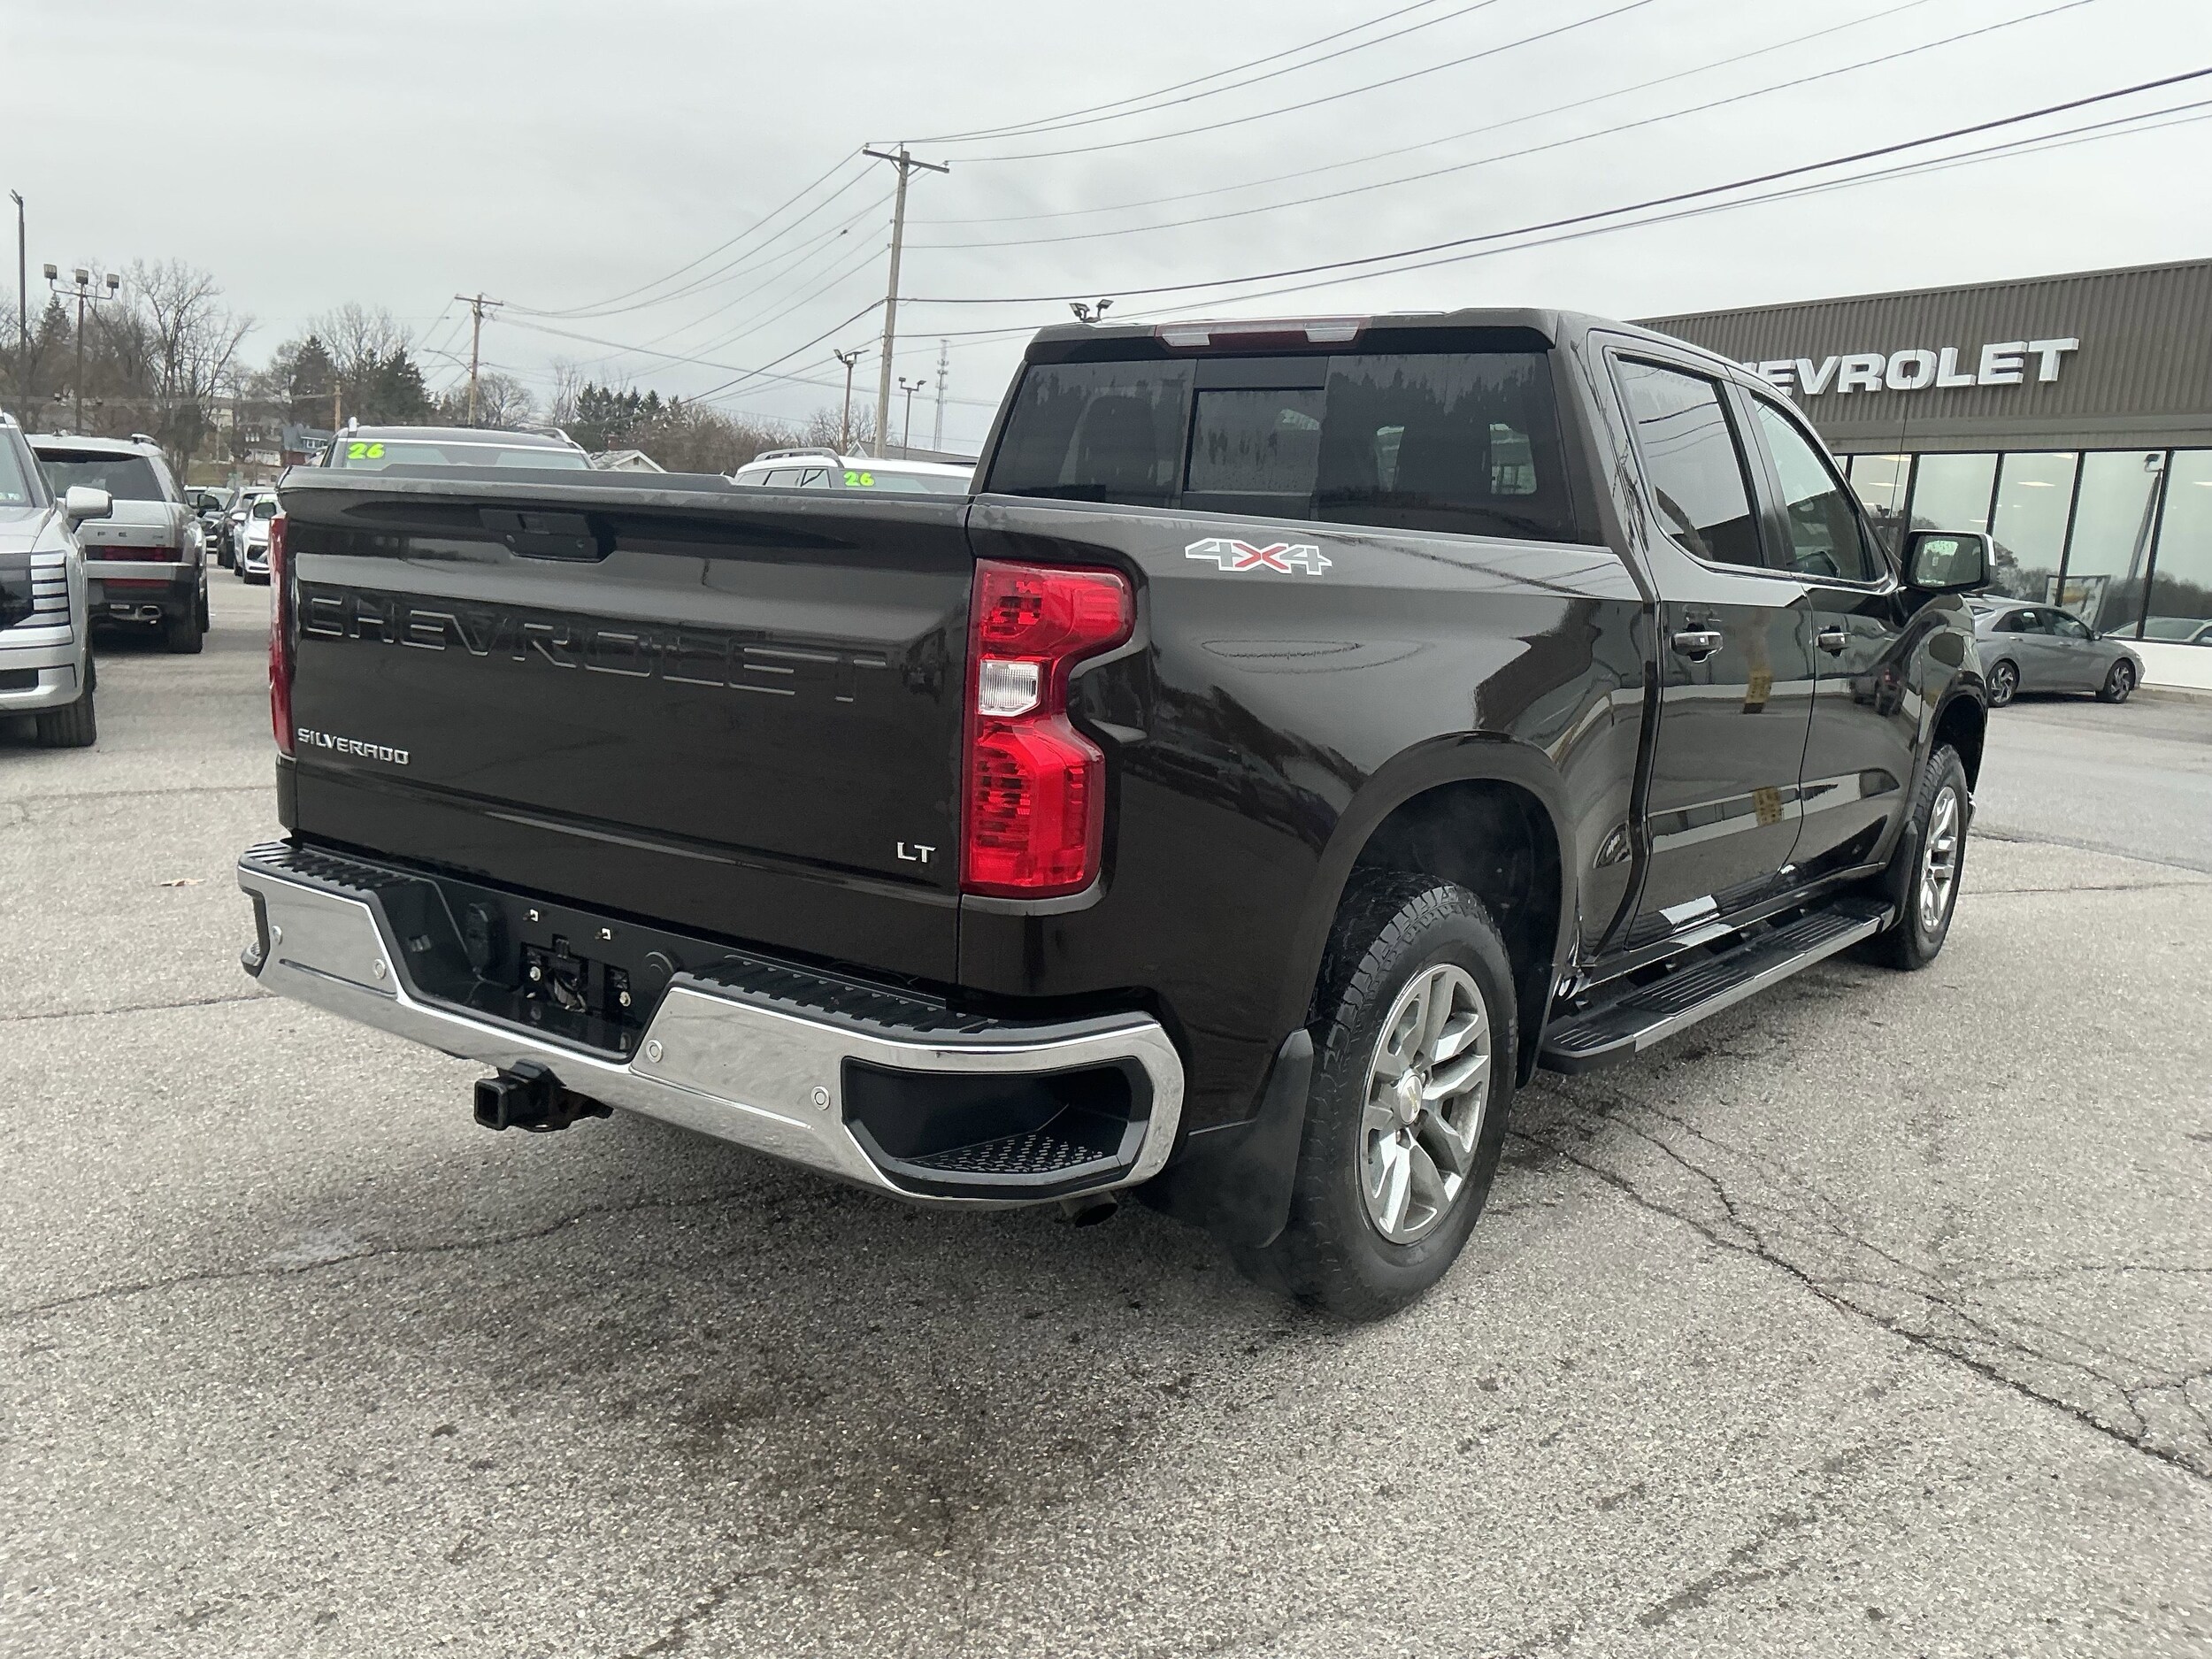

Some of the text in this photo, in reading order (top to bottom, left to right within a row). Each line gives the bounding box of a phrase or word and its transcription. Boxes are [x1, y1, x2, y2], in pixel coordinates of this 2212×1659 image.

[1743, 337, 2080, 396] EVROLET
[347, 442, 385, 459] 26
[843, 470, 876, 487] 26
[299, 595, 888, 703] CHEVROLET
[297, 727, 410, 765] SILVERADO
[896, 841, 937, 864] LT
